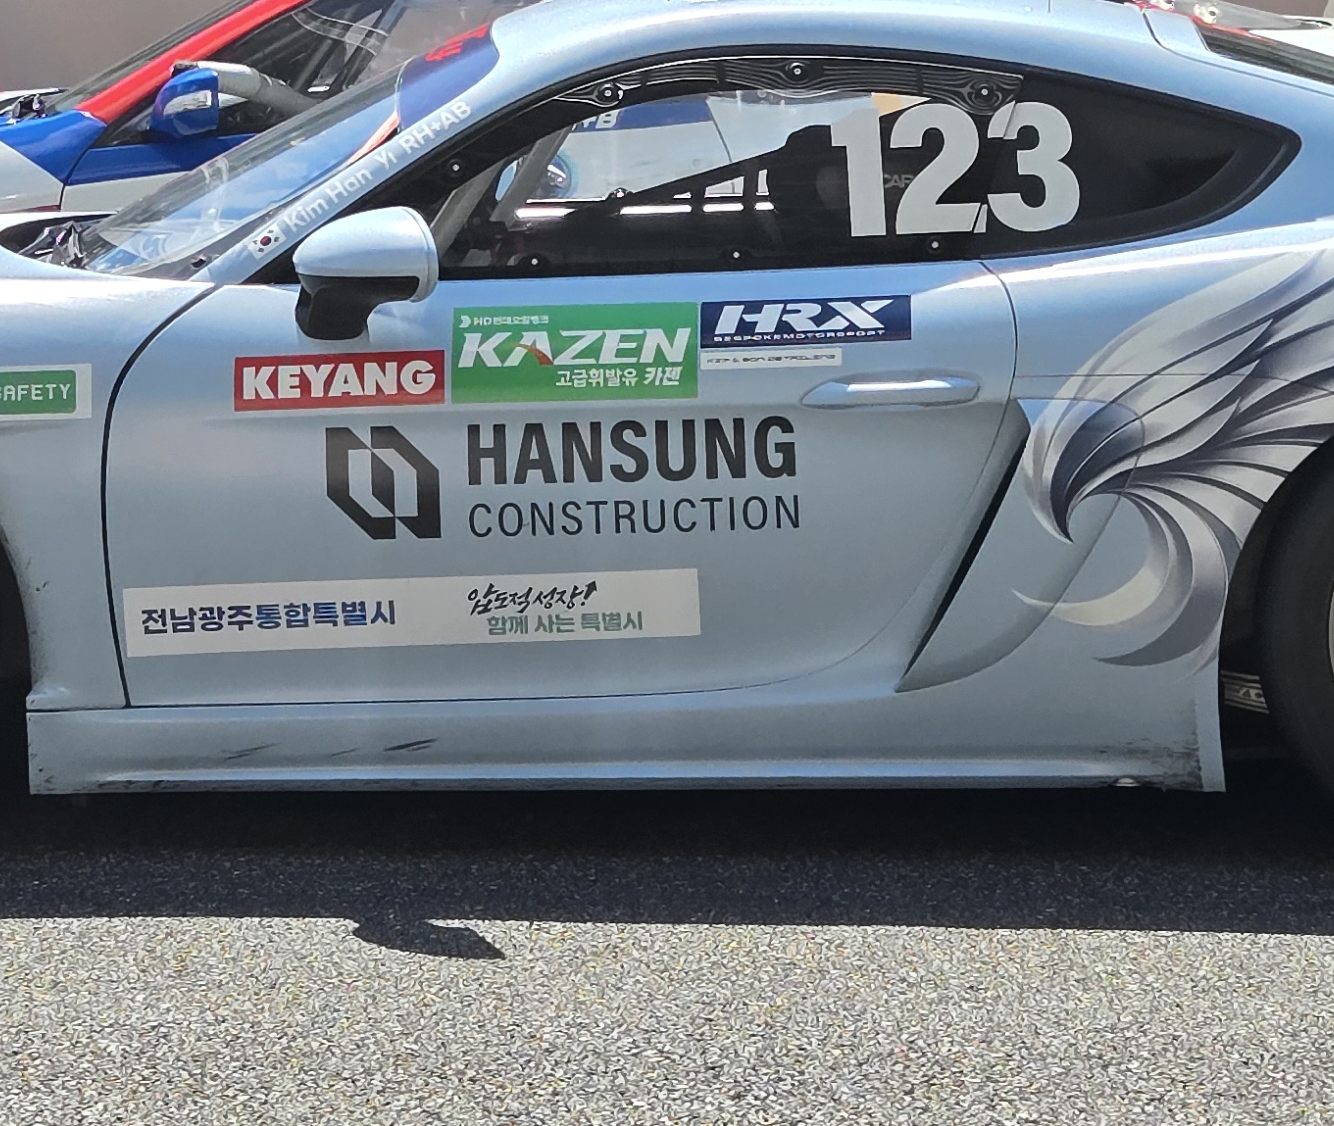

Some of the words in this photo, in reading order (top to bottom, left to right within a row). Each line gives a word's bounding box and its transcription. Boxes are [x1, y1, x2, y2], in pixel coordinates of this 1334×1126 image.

[283, 195, 330, 233] Kim
[398, 101, 472, 155] RH+AB
[829, 100, 1081, 237] 123
[714, 299, 895, 335] HRX
[457, 326, 692, 368] KAZEN
[241, 359, 437, 400] KEYANG
[555, 367, 639, 388] 고급휘발유
[467, 415, 797, 486] HANSUNG
[468, 494, 801, 538] CONSTRUCTION
[141, 600, 396, 635] 전남광주통합특별시
[486, 615, 529, 636] 함께
[534, 613, 576, 633] 사는
[581, 611, 644, 632] 특별시
